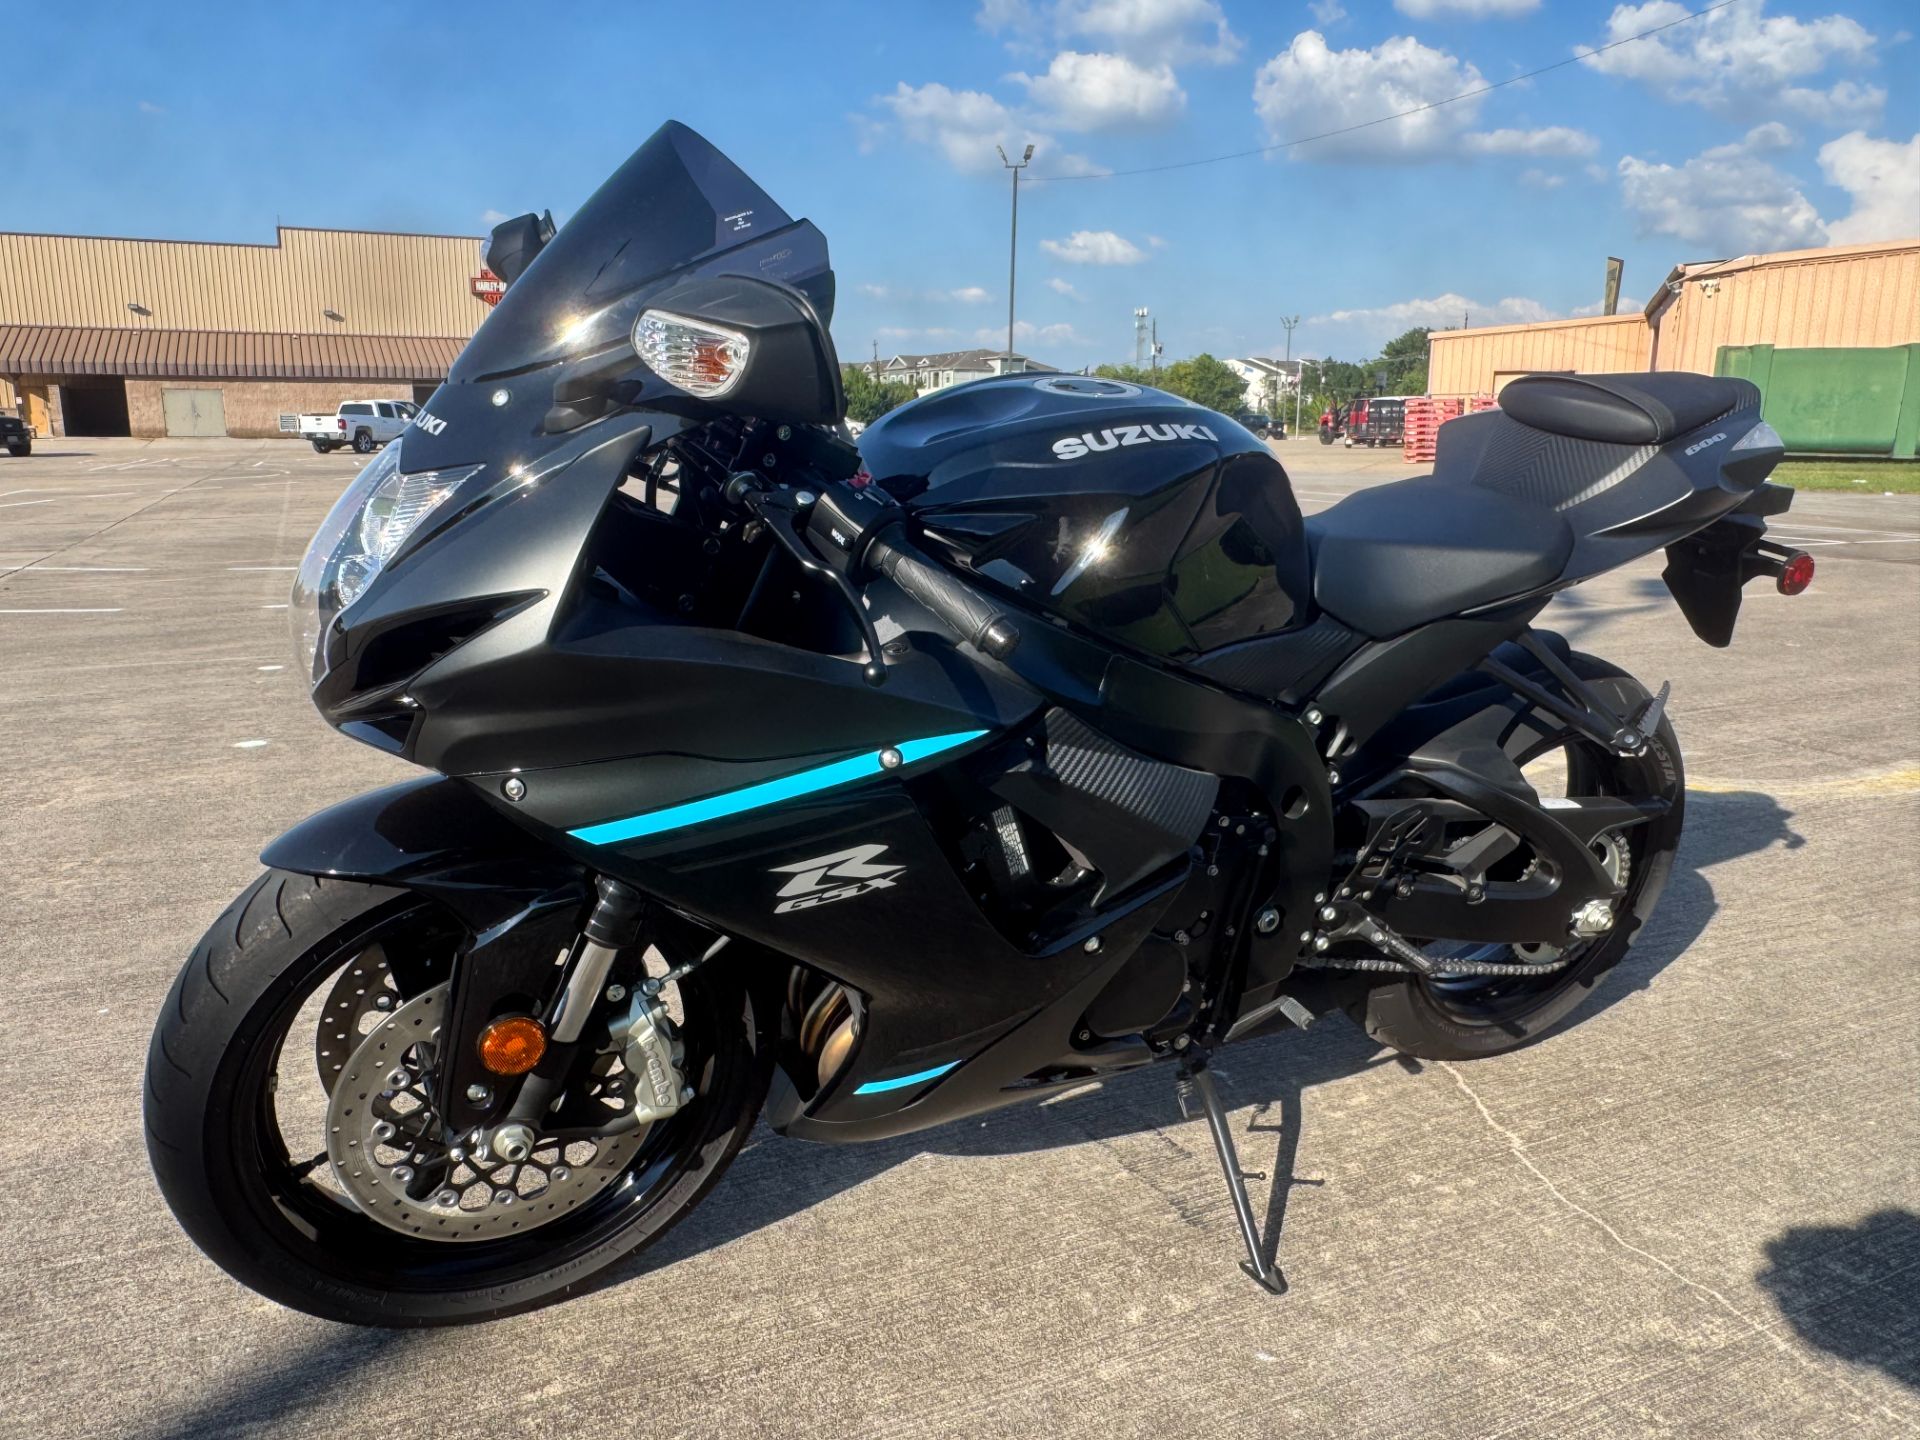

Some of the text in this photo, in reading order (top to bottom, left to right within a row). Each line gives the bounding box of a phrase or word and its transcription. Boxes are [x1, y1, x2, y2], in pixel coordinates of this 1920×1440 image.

[413, 409, 448, 436] UKI
[1052, 424, 1219, 460] SUZUKI
[1685, 432, 1727, 456] 600
[767, 844, 907, 897] R
[773, 869, 907, 914] GSX
[641, 1036, 672, 1106] brembo
